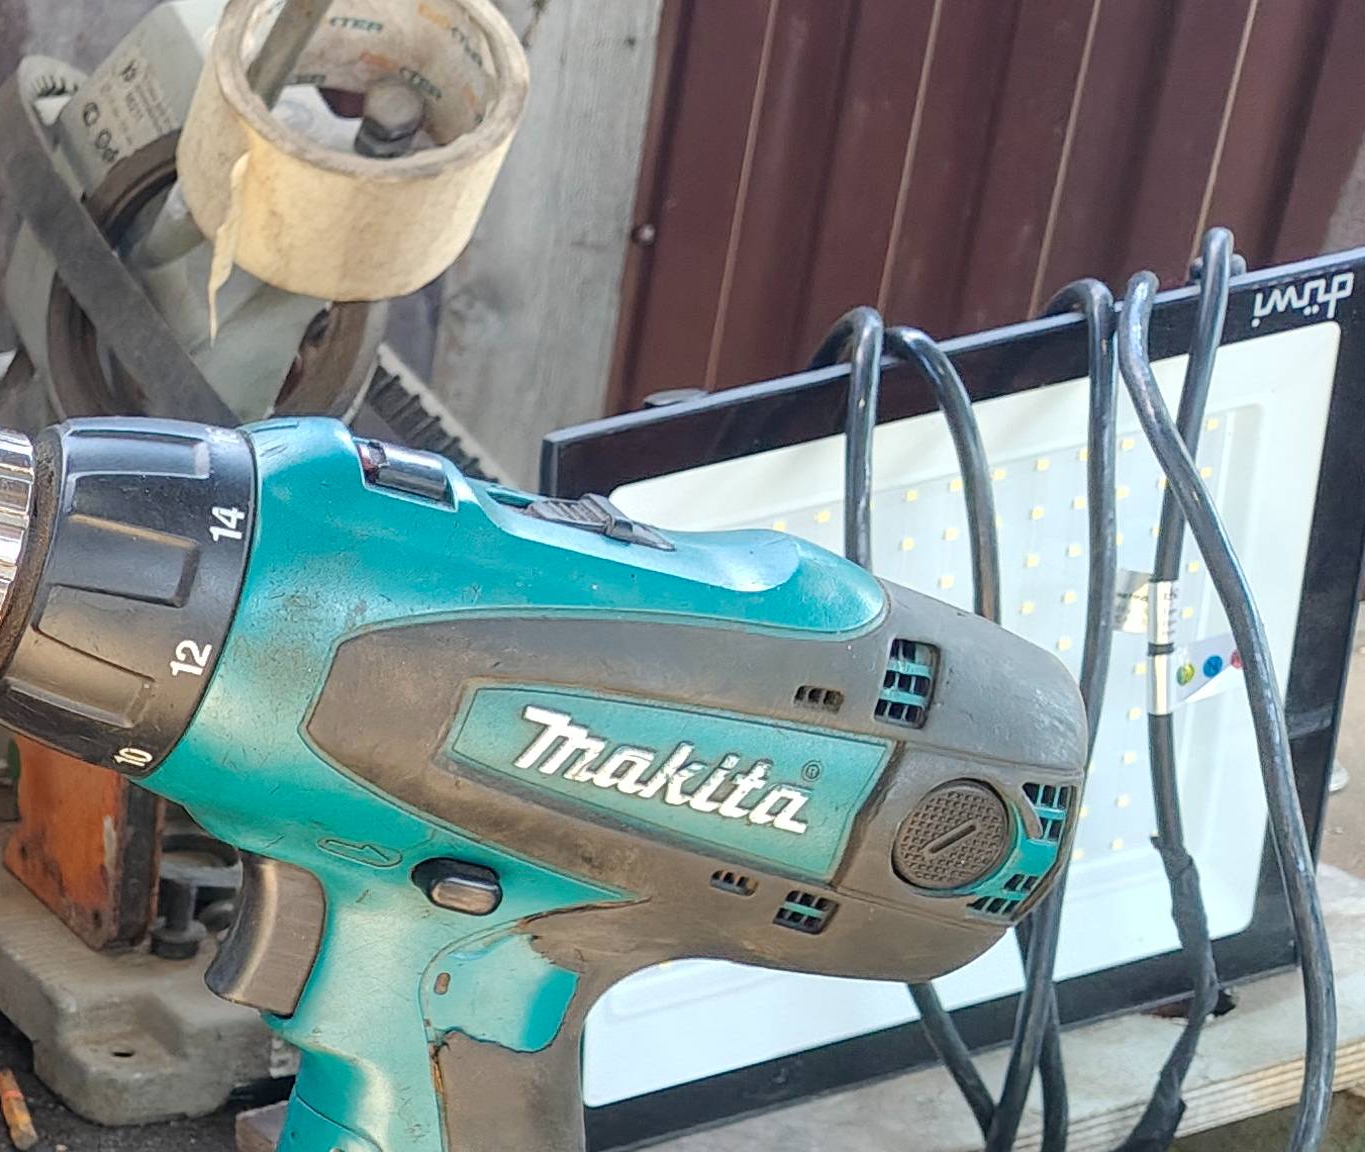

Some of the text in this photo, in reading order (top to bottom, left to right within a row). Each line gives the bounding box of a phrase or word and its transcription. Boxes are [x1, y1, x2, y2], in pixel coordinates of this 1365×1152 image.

[1251, 272, 1355, 328] düwi
[209, 506, 246, 542] 14
[170, 639, 213, 677] 12
[113, 747, 154, 768] 10
